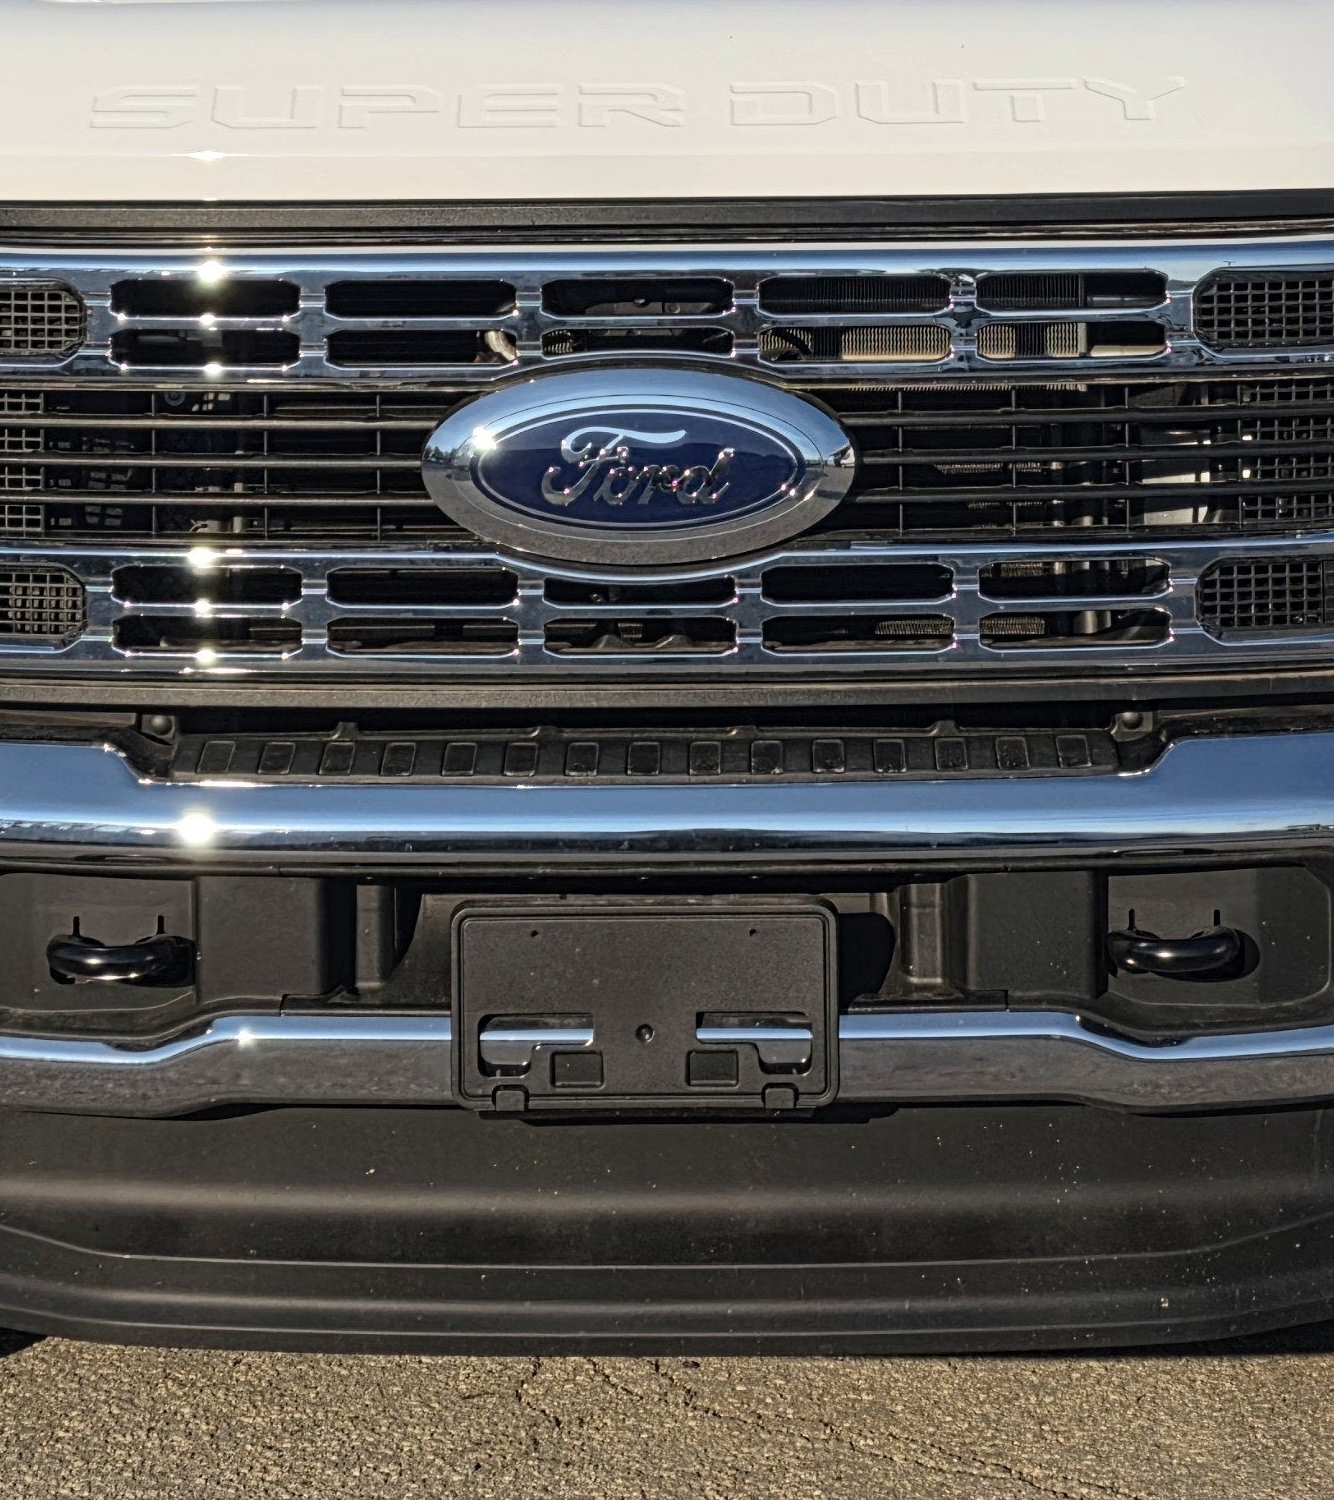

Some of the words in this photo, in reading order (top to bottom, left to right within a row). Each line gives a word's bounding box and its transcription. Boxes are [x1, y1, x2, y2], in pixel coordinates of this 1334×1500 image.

[89, 83, 686, 129] SUPER
[729, 77, 1187, 126] DUTY
[541, 425, 736, 506] Ford
